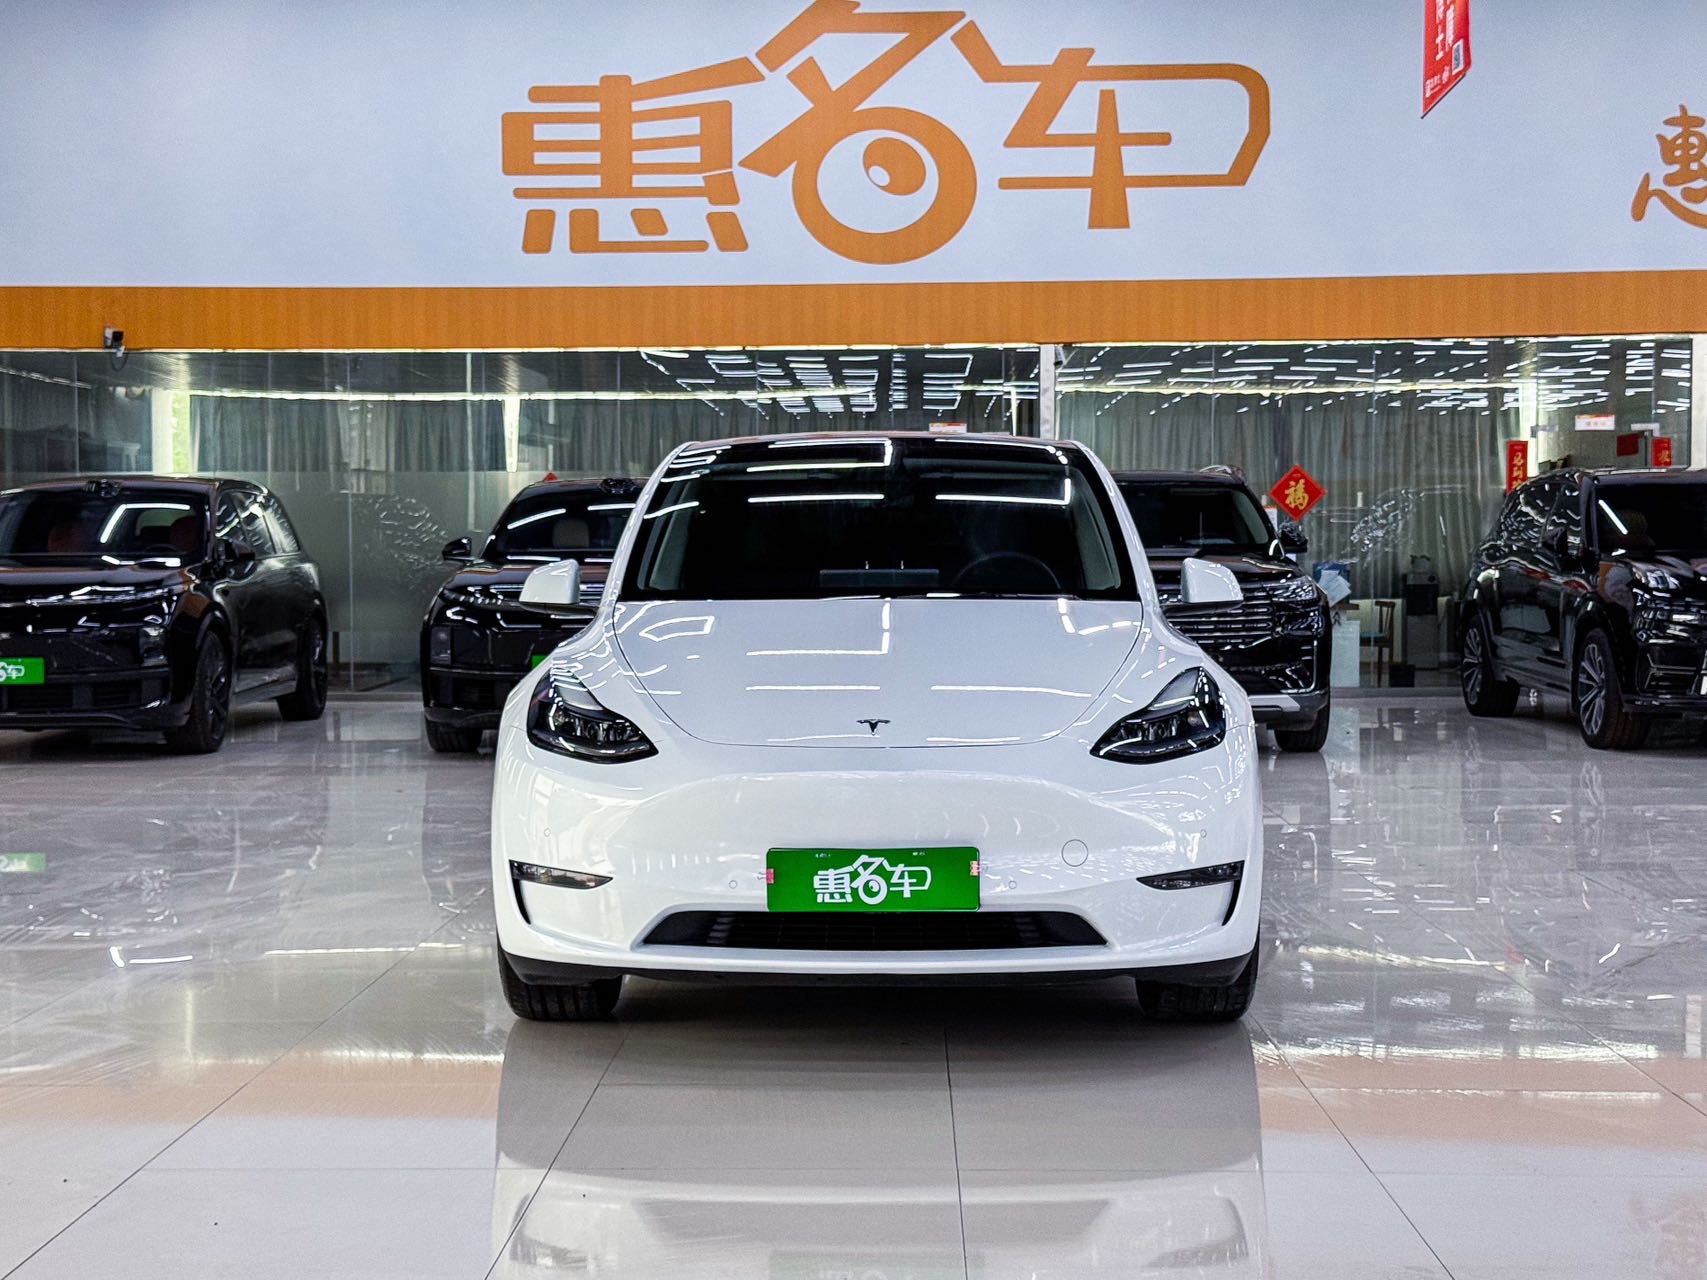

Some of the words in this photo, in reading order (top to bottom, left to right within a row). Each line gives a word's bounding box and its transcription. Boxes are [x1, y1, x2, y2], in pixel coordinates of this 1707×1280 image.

[501, 0, 1271, 265] 惠名车
[1285, 478, 1309, 510] 福
[813, 854, 932, 905] 惠名车
